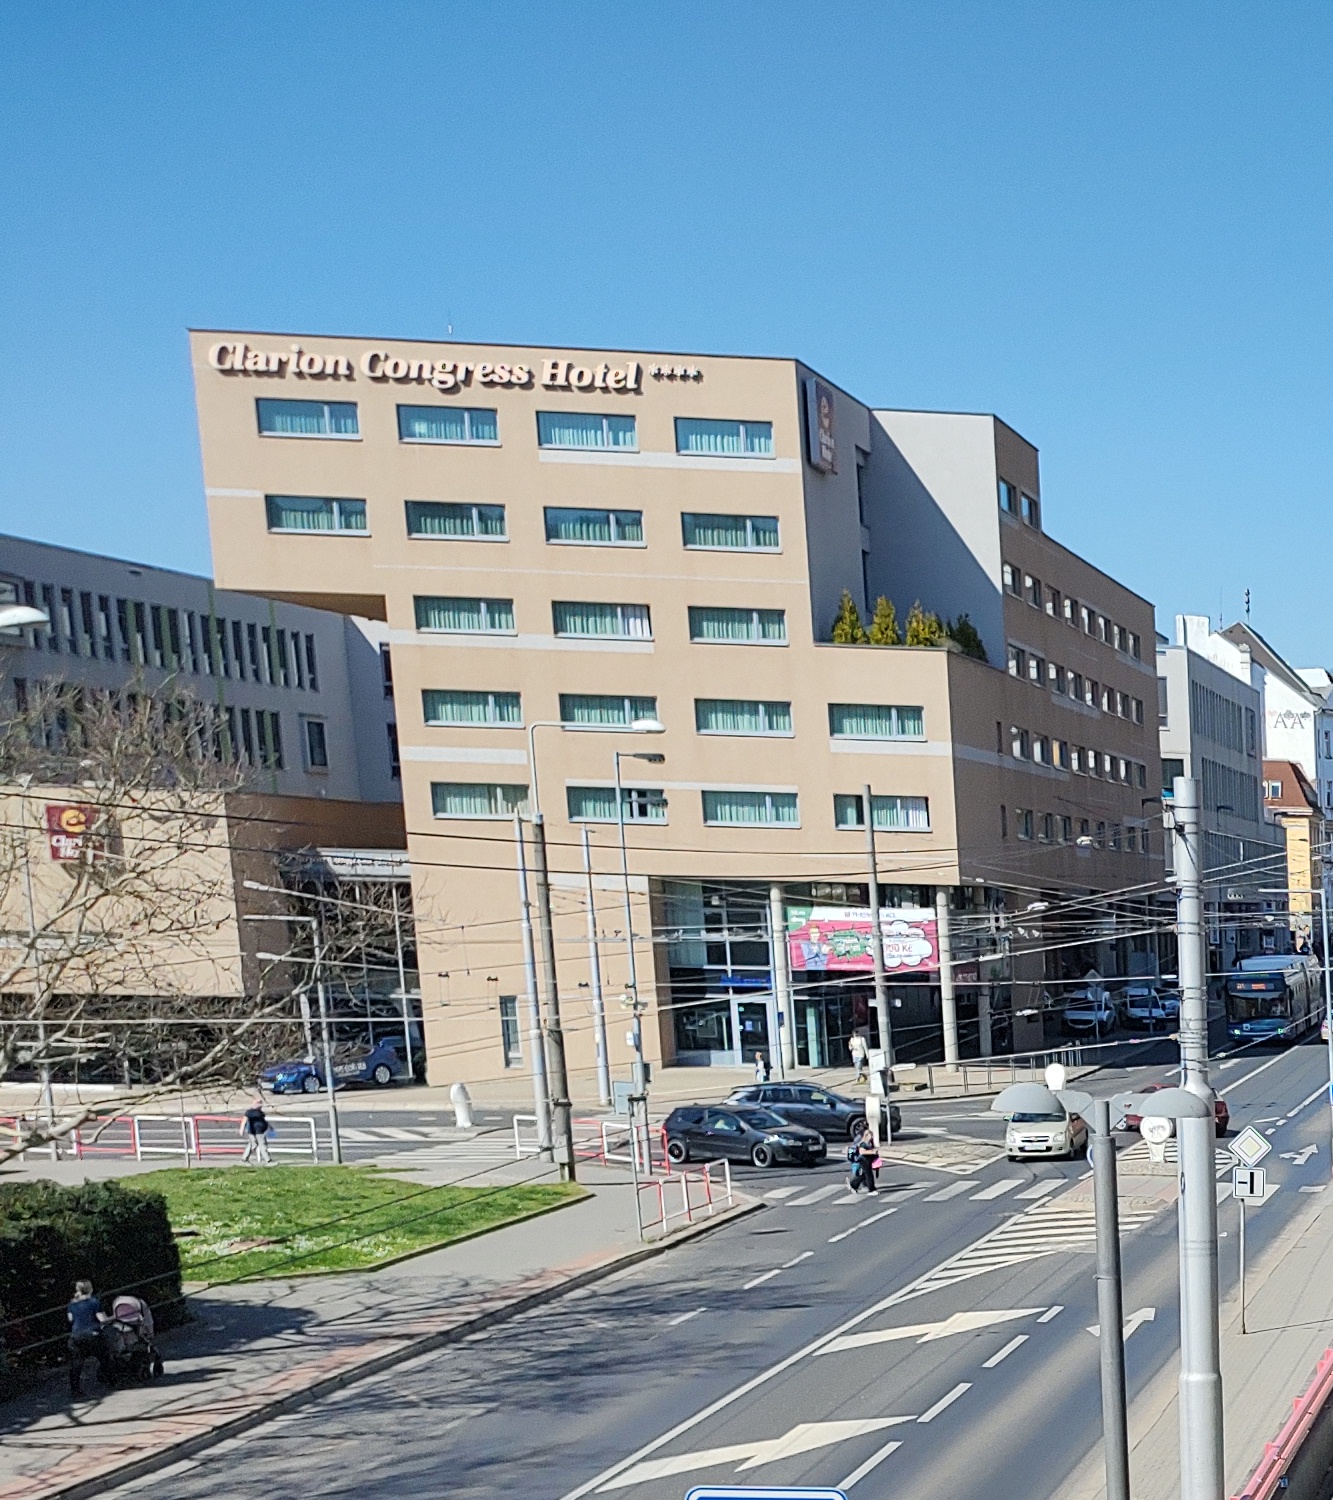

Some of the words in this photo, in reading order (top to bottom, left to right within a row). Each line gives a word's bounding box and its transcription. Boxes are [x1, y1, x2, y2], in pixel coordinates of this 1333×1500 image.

[208, 341, 351, 376] Clarion
[360, 350, 531, 390] Congress
[541, 358, 640, 390] Hotel
